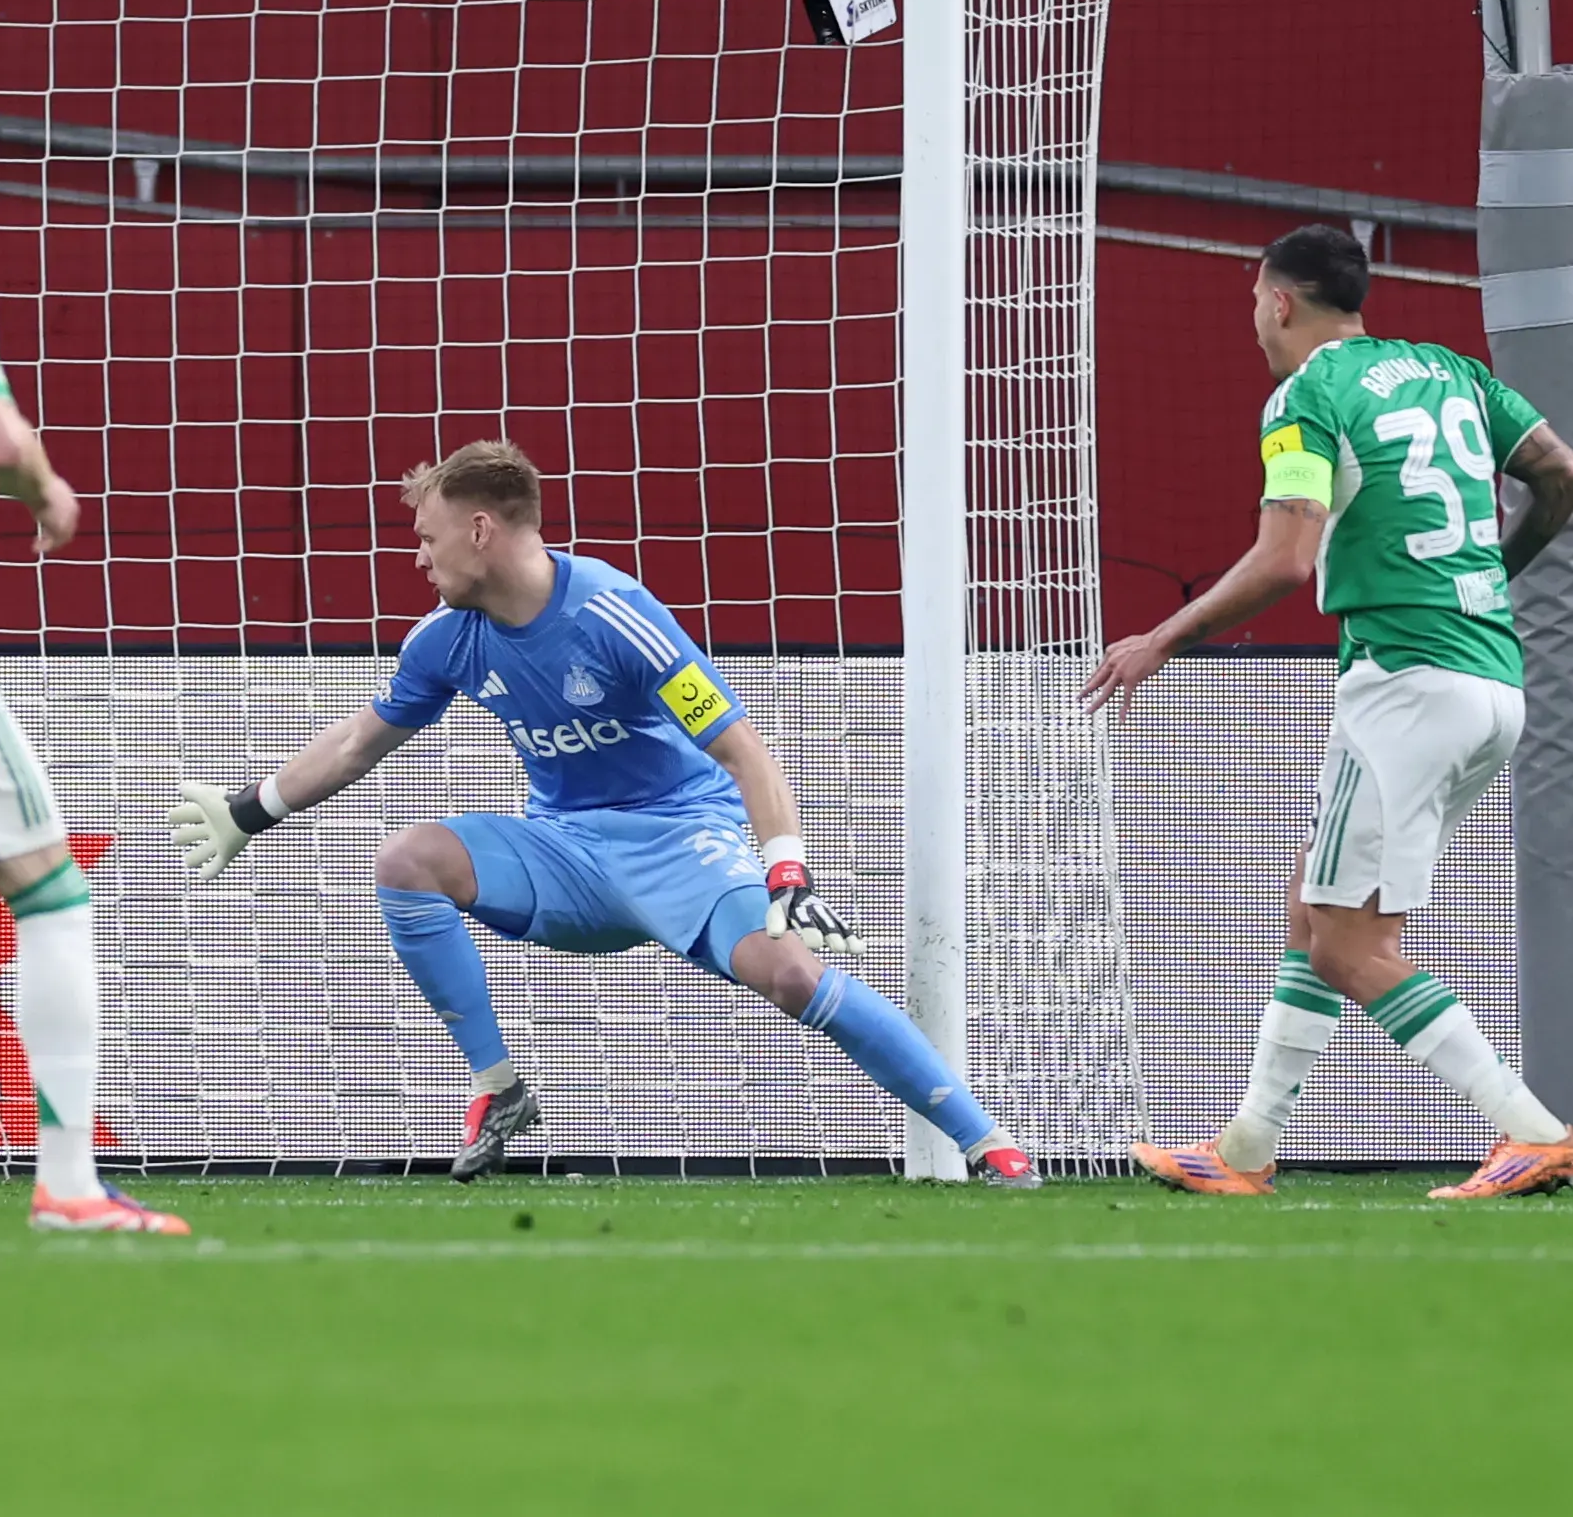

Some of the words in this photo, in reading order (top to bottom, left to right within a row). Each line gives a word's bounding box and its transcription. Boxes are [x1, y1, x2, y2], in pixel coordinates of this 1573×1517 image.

[1360, 357, 1431, 400] BRUNO
[1373, 396, 1500, 561] 39
[683, 691, 722, 727] noon
